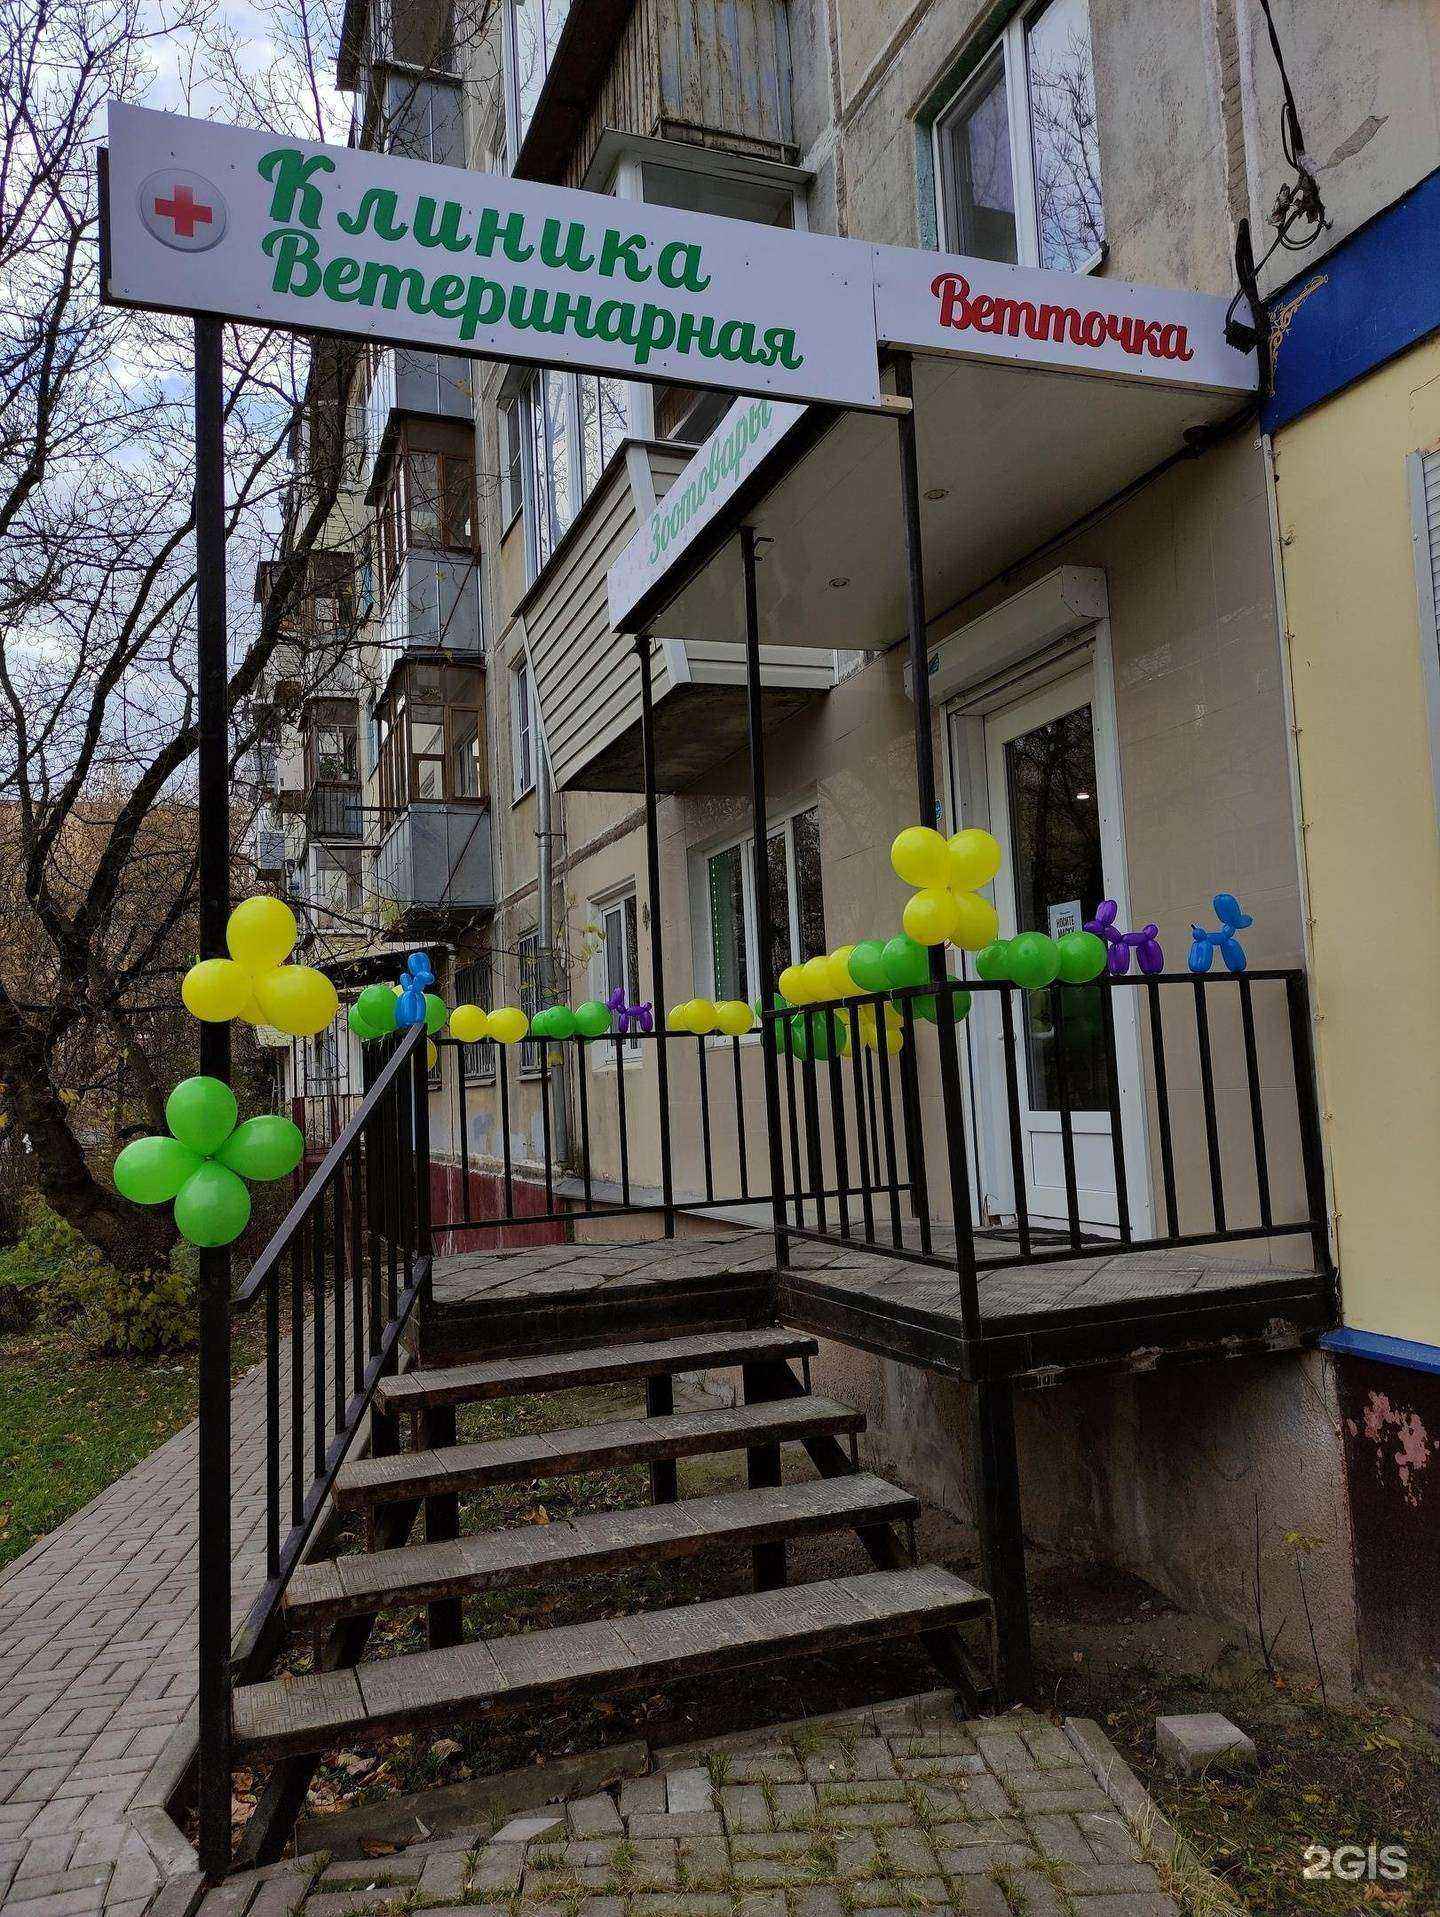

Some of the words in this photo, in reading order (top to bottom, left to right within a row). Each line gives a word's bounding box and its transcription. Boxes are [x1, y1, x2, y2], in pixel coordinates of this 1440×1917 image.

[257, 148, 712, 292] Клиника
[261, 228, 805, 369] Ветеринарная
[930, 272, 1194, 362] Ветточка
